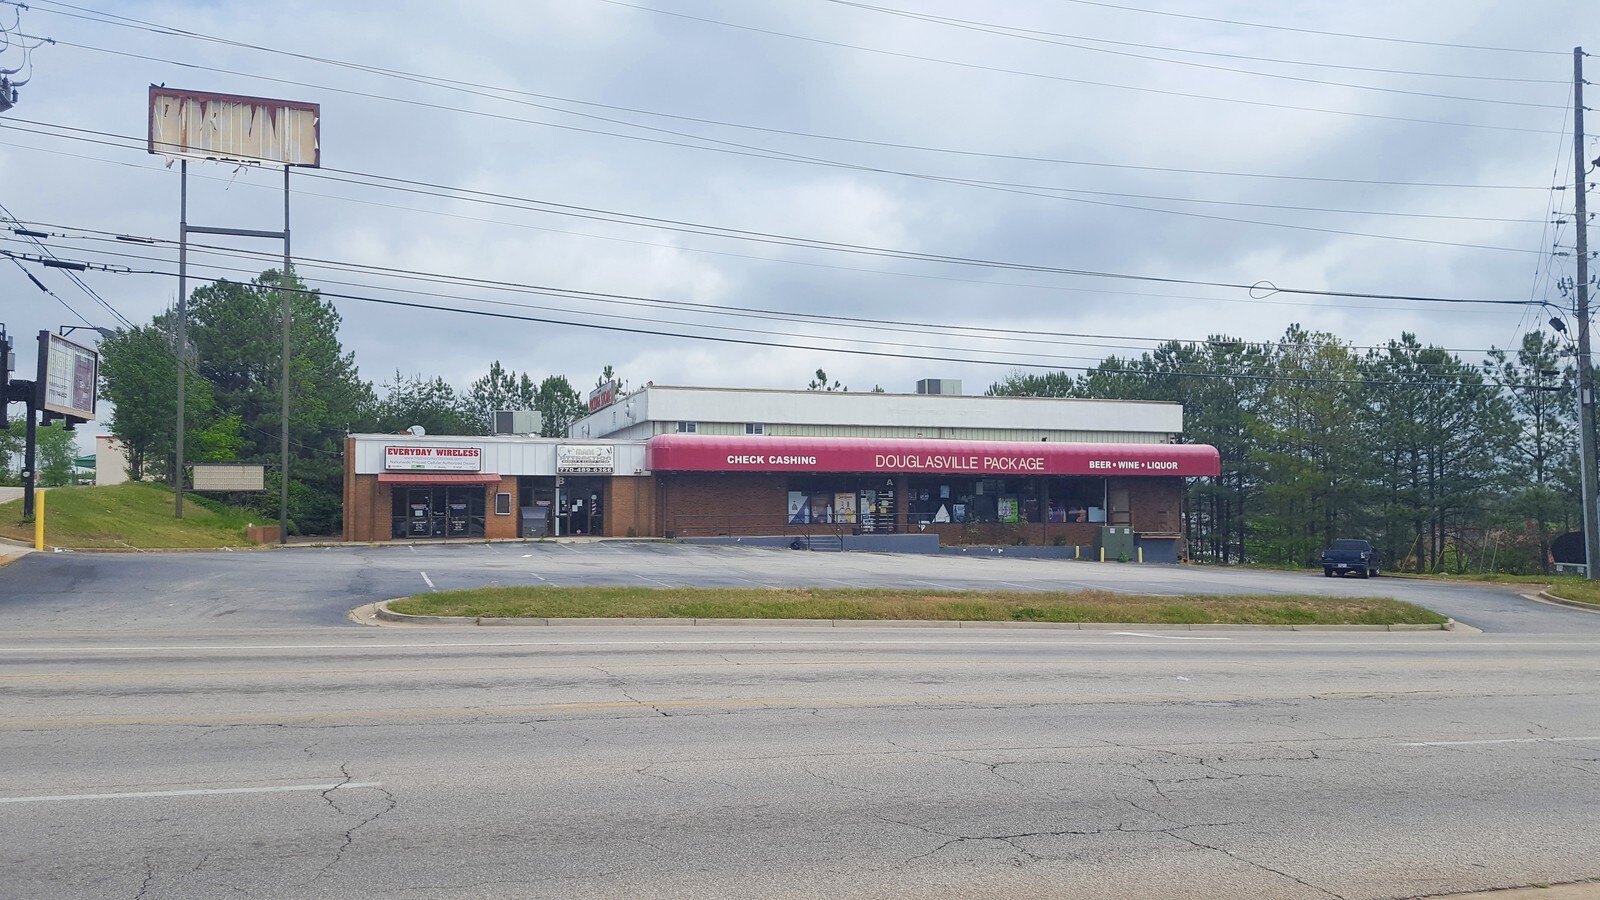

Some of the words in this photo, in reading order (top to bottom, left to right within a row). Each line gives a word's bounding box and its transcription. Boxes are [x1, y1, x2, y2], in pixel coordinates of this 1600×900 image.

[387, 448, 432, 456] EVERYDAY
[436, 449, 479, 457] WIRELESS
[727, 455, 765, 464] CHECK
[768, 455, 817, 465] CASHING
[875, 454, 979, 469] DOUGLASVILLE
[984, 457, 1045, 470] PACKAGE
[1089, 460, 1112, 469] BEER
[1117, 461, 1140, 469] WINE
[1146, 461, 1178, 470] LIQUOR
[559, 476, 565, 485] B
